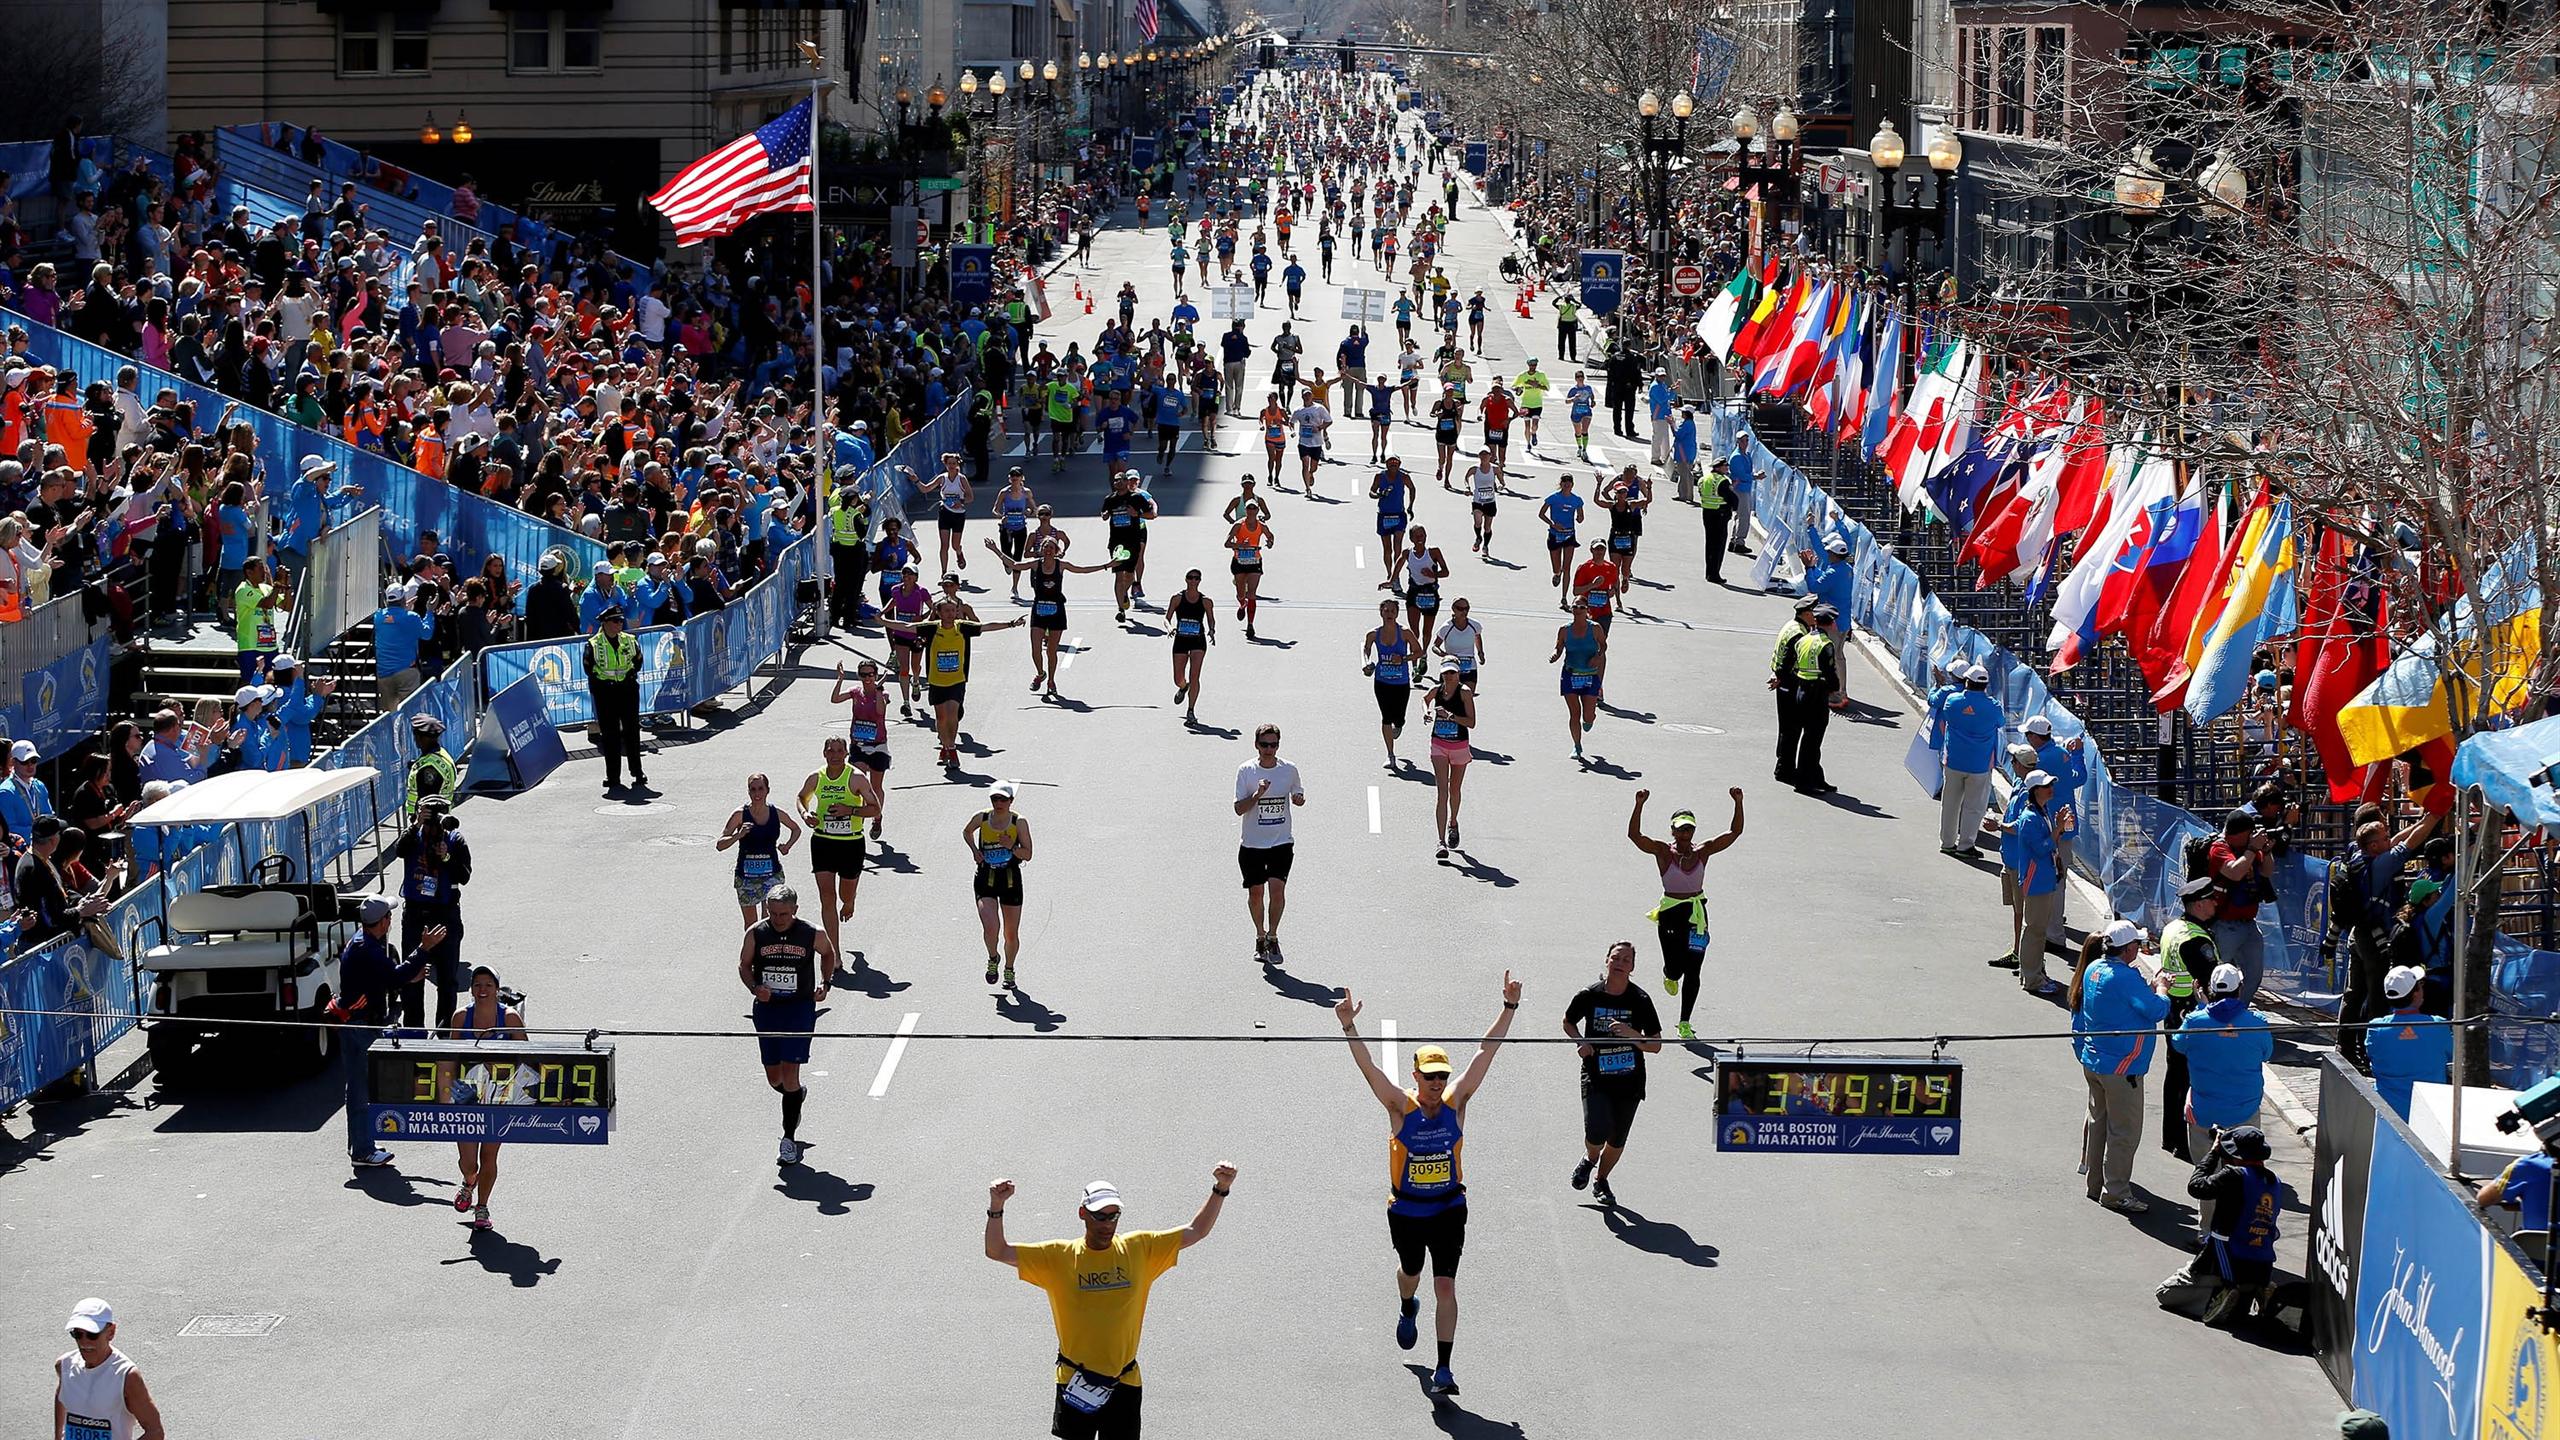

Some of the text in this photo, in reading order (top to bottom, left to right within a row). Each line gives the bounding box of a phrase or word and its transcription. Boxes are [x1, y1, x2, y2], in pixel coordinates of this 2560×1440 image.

[927, 180, 950, 189] EXETER
[526, 182, 588, 201] Lindt
[639, 670, 668, 682] BOSTON
[546, 681, 588, 694] MARATHON
[1259, 805, 1285, 814] 14239
[825, 821, 851, 830] 14734
[760, 944, 807, 957] COAST GUARD
[764, 973, 796, 984] 14361
[1601, 1054, 1633, 1066] 18186
[414, 1062, 596, 1102] 3:49:09
[1763, 1073, 1950, 1115] 3:49:09
[408, 1112, 434, 1123] 2014
[438, 1112, 486, 1123] BOSTON
[408, 1123, 486, 1135] MARATHON
[1758, 1123, 1837, 1134] 2014 BOSTON
[1758, 1134, 1837, 1146] MARATHON
[1425, 1152, 1449, 1161] adidas
[1410, 1162, 1449, 1175] 30955
[2316, 1227, 2349, 1300] adidas
[2369, 1237, 2464, 1436] John Hancock
[82, 1418, 110, 1427] adidas
